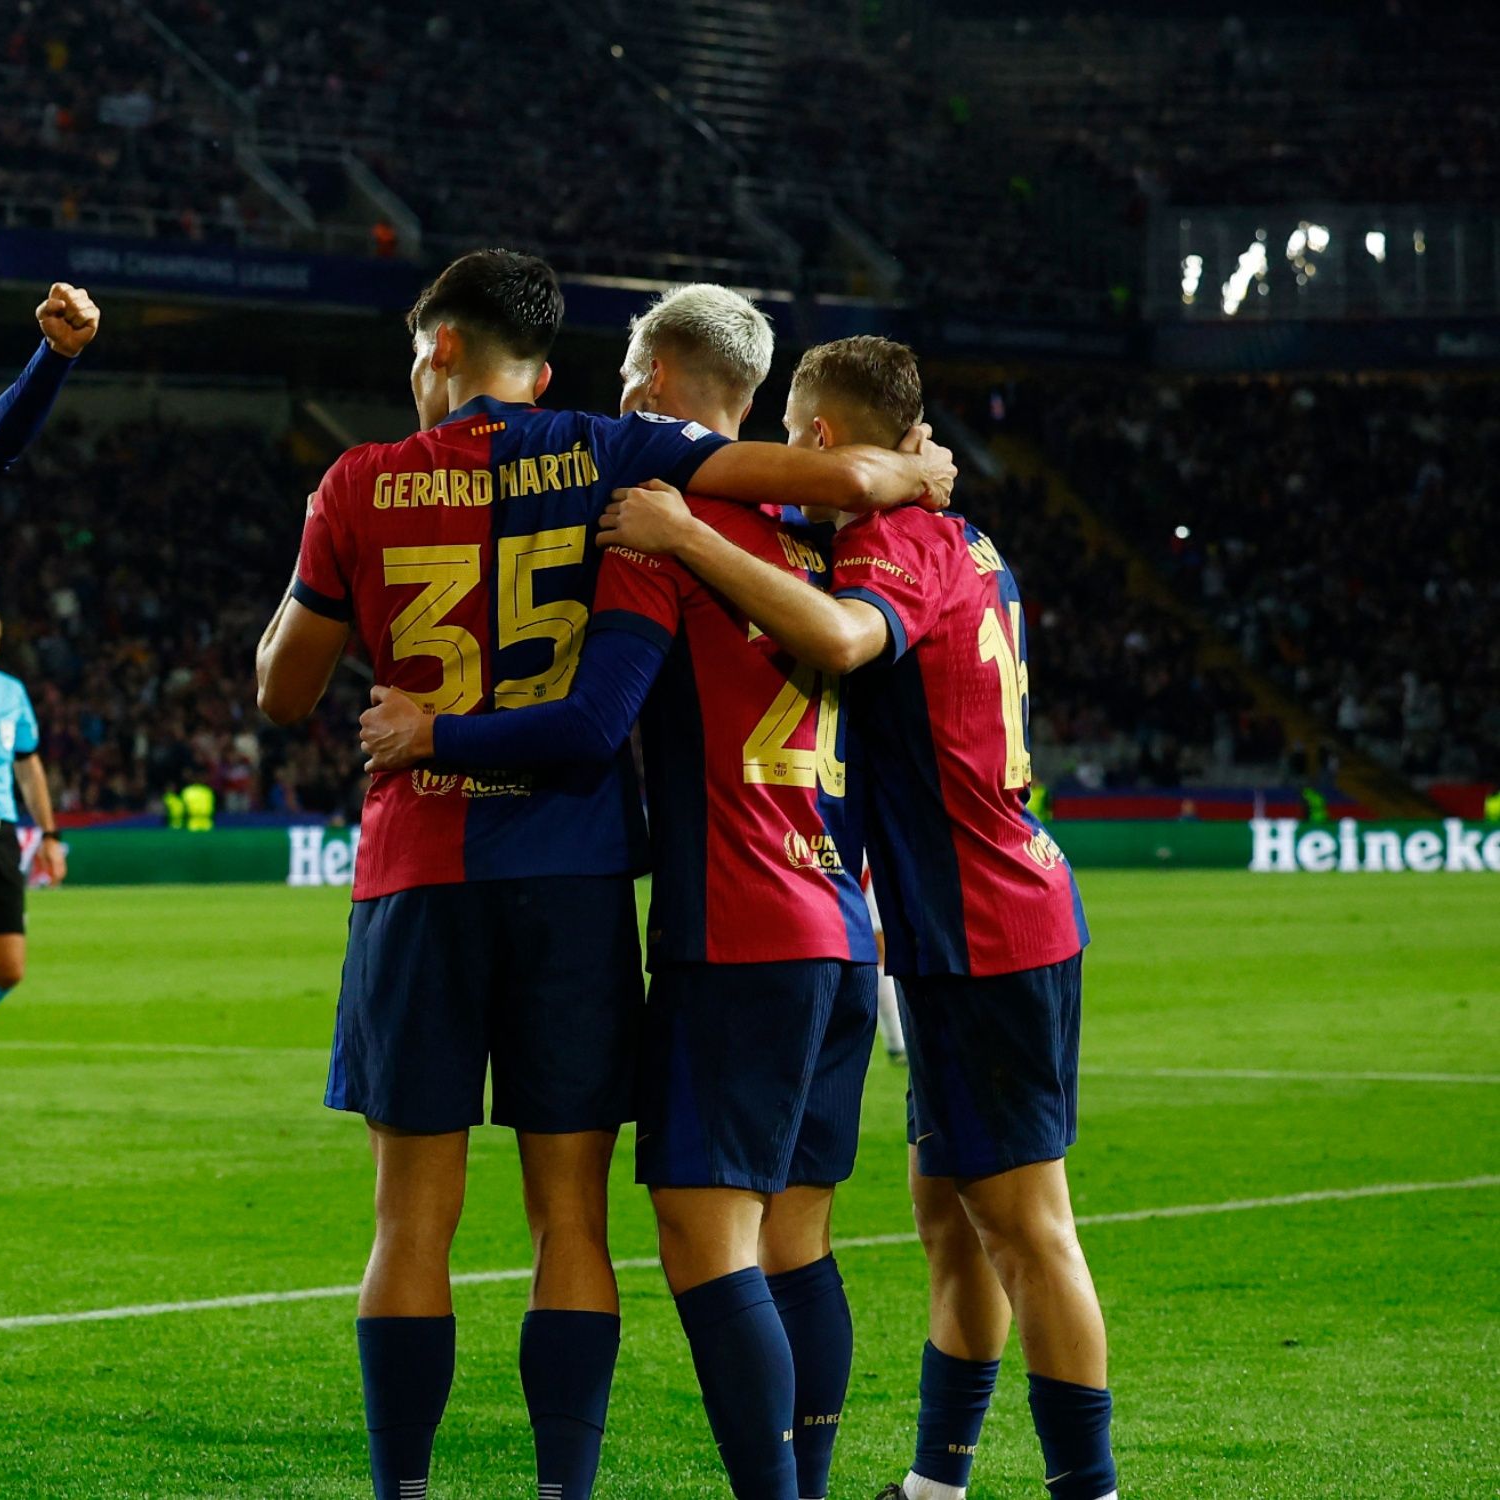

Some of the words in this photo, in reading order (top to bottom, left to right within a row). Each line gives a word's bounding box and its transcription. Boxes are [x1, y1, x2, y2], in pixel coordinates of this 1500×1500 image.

[373, 469, 493, 509] GERARD
[834, 556, 904, 578] AMBILIGHT
[382, 524, 590, 715] 35
